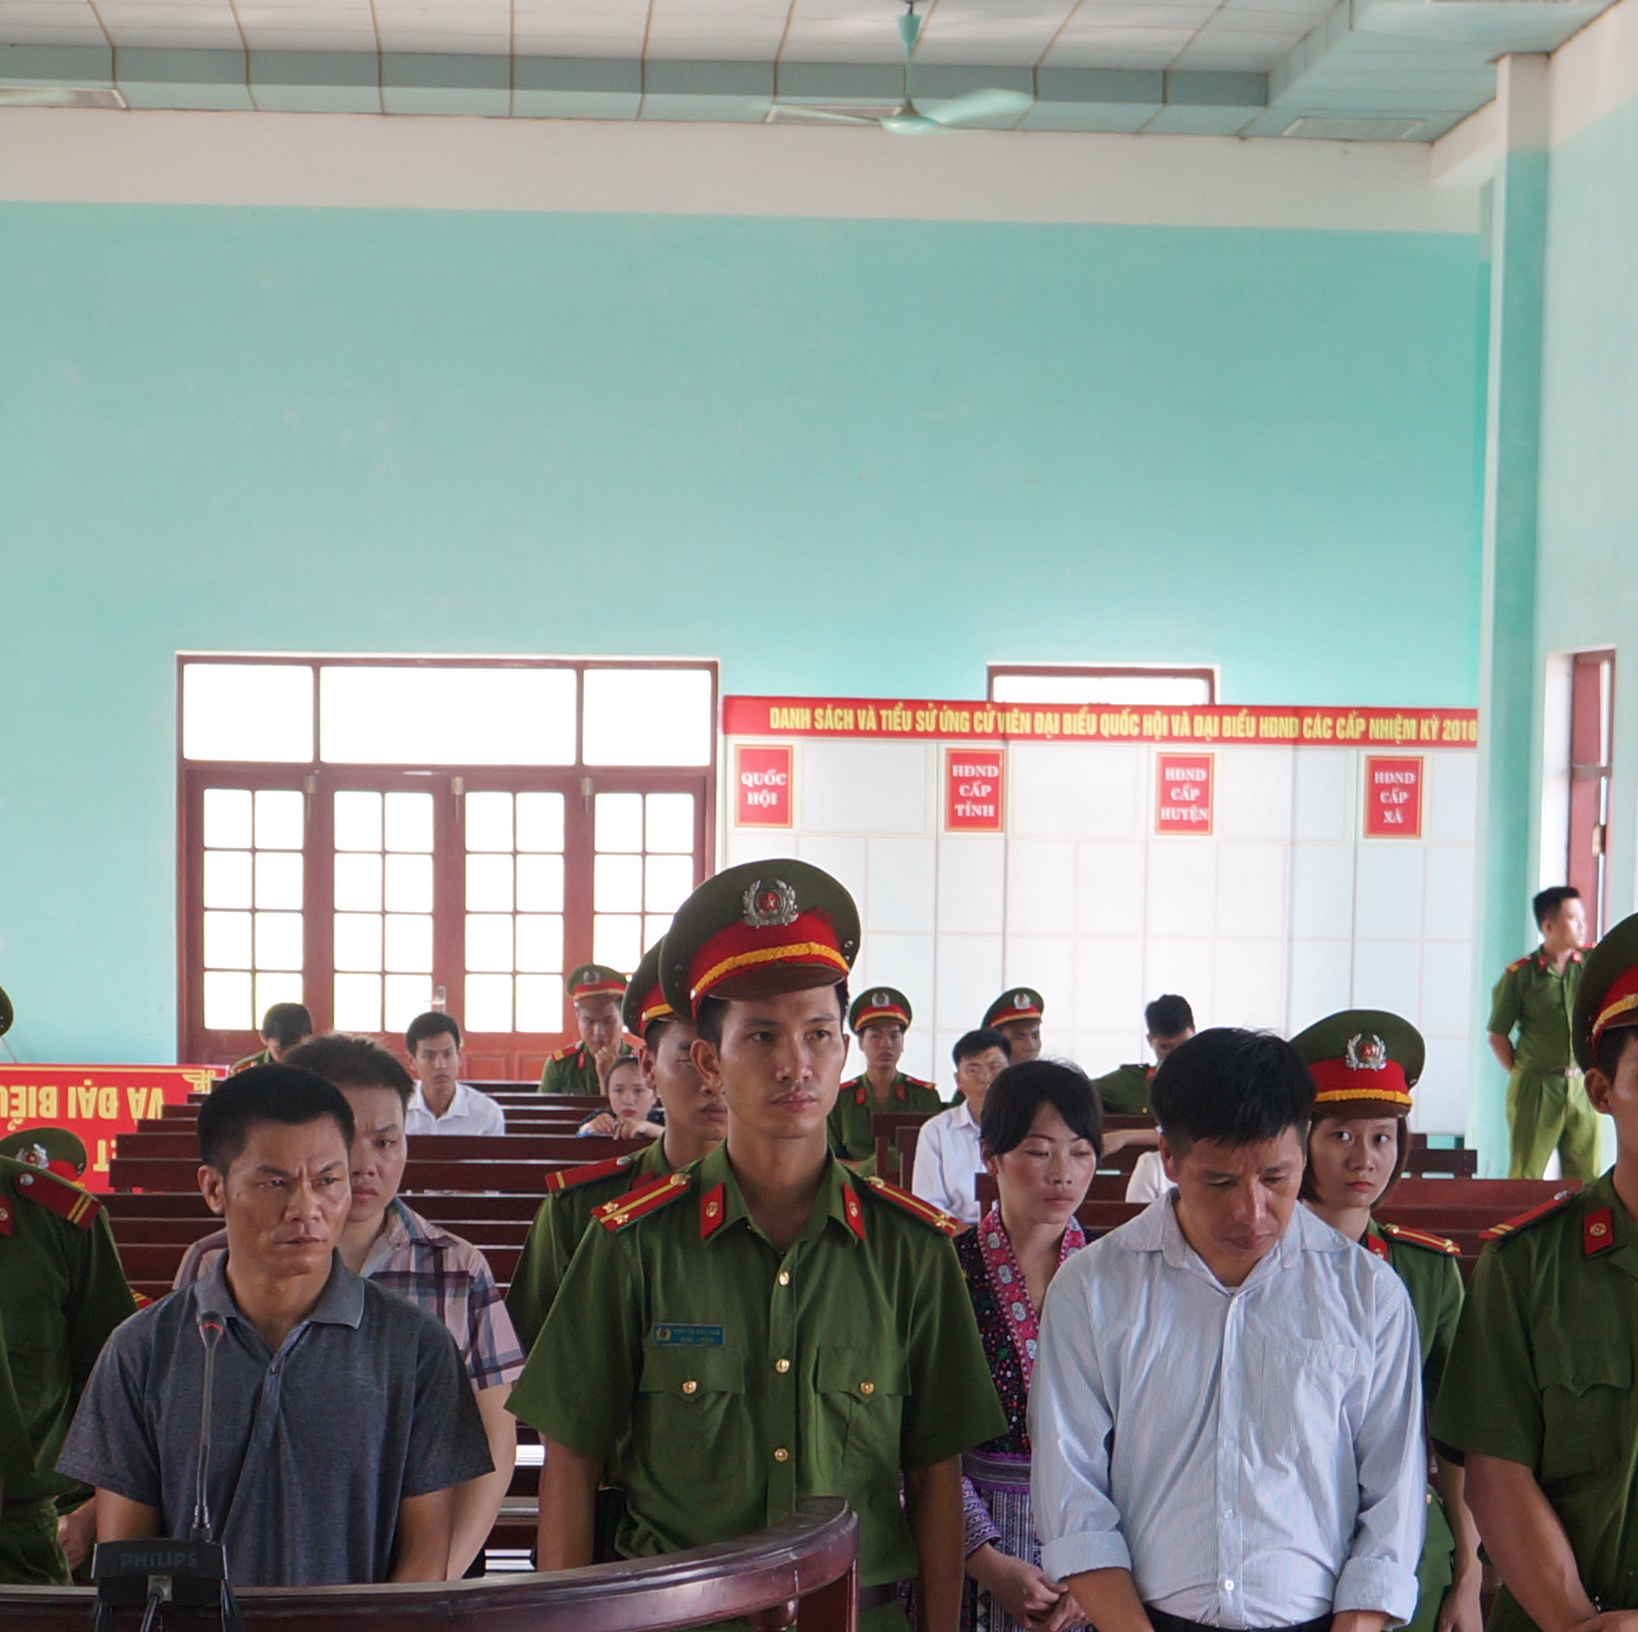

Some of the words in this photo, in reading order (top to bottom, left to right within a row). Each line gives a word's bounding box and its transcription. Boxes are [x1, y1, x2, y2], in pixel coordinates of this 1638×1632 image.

[769, 707, 812, 729] DANH
[814, 704, 854, 730] SÁCH
[857, 704, 877, 731] VÀ
[997, 708, 1031, 734] VIÊN
[1100, 707, 1140, 738] QUỐC
[1142, 710, 1168, 741] HỘI
[1171, 710, 1191, 737] VÀ
[1303, 712, 1333, 739] CÁC
[1336, 710, 1366, 739] CẤP
[1369, 713, 1417, 744] NHIỆM
[1442, 719, 1477, 741] 2016
[741, 768, 787, 787] QUỐC
[959, 780, 992, 797] CẤP
[1170, 784, 1201, 801] CẤP
[1380, 787, 1410, 804] CẤP
[747, 789, 778, 808] HỘI
[1161, 805, 1208, 823] HUYỆN
[68, 1080, 118, 1119] ĐẠI
[120, 1551, 198, 1568] PHILIPS
